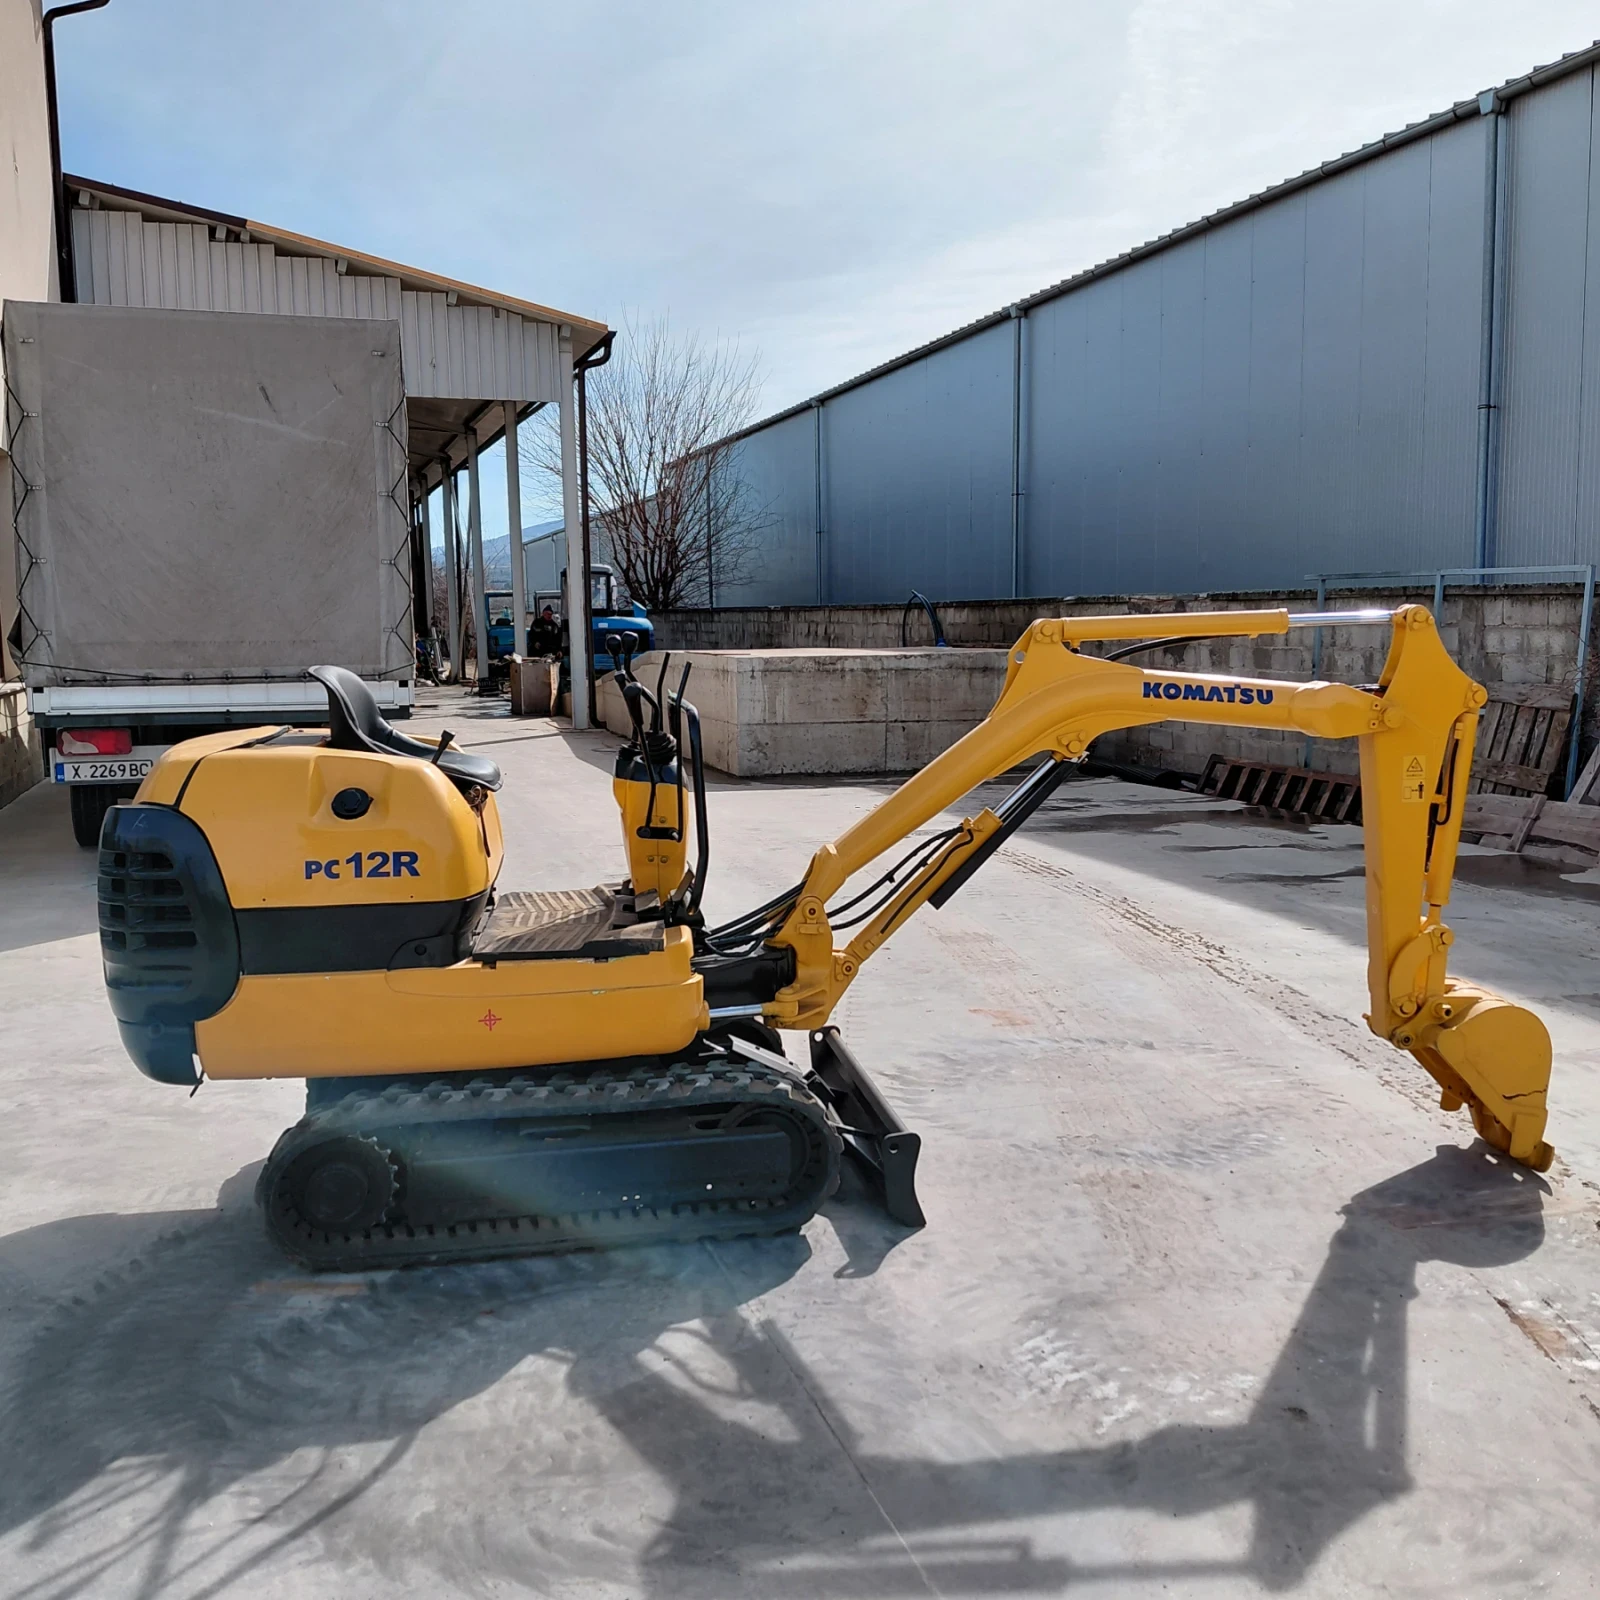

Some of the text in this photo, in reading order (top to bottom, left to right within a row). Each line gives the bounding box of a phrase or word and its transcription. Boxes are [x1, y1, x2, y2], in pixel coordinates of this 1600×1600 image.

[1142, 682, 1274, 705] KOMATSU
[304, 851, 421, 880] PC 12R
